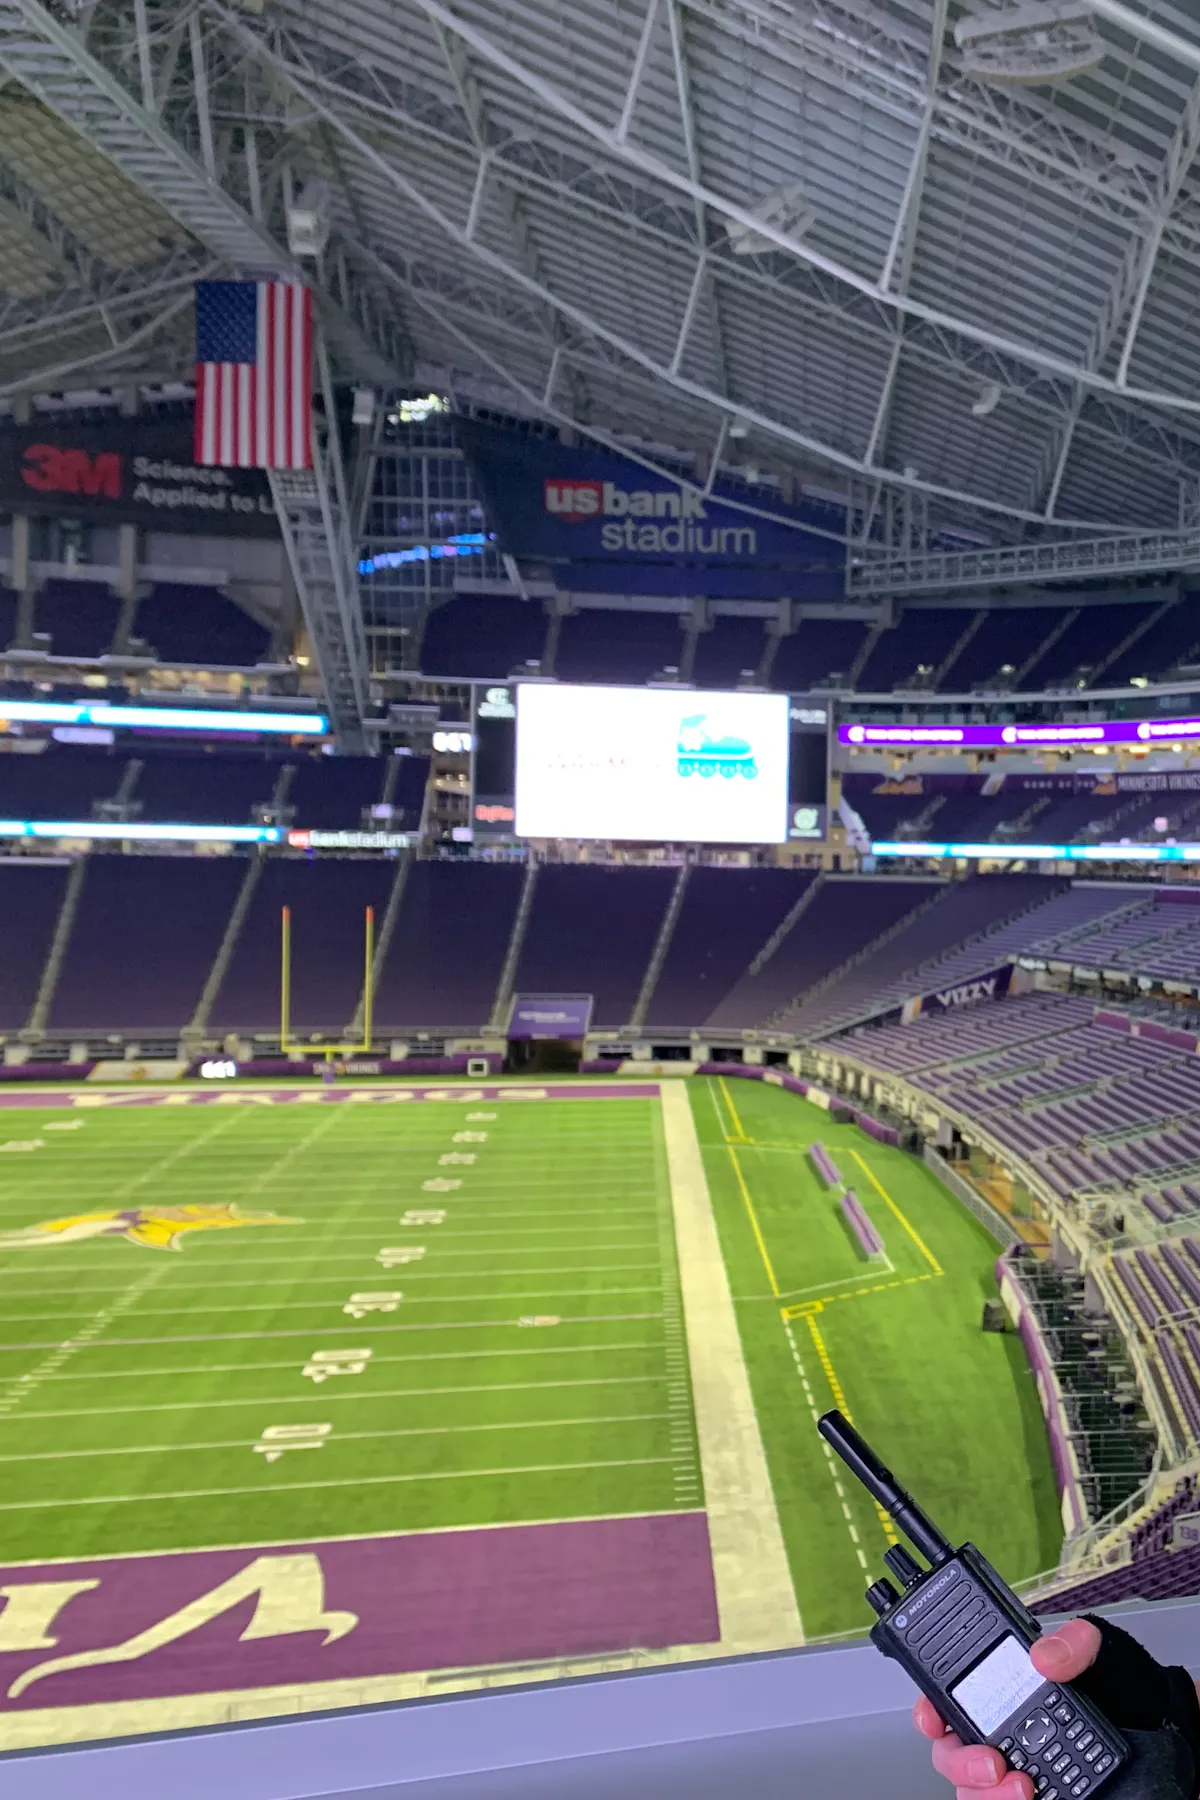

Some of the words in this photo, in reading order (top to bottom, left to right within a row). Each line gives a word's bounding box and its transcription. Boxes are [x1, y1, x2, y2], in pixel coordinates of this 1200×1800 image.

[21, 444, 121, 498] 3M
[132, 482, 226, 509] Applied
[230, 493, 256, 514] to
[601, 518, 757, 554] stadium
[937, 978, 998, 1008] VIZZY
[908, 1569, 957, 1616] MOTOROLA
